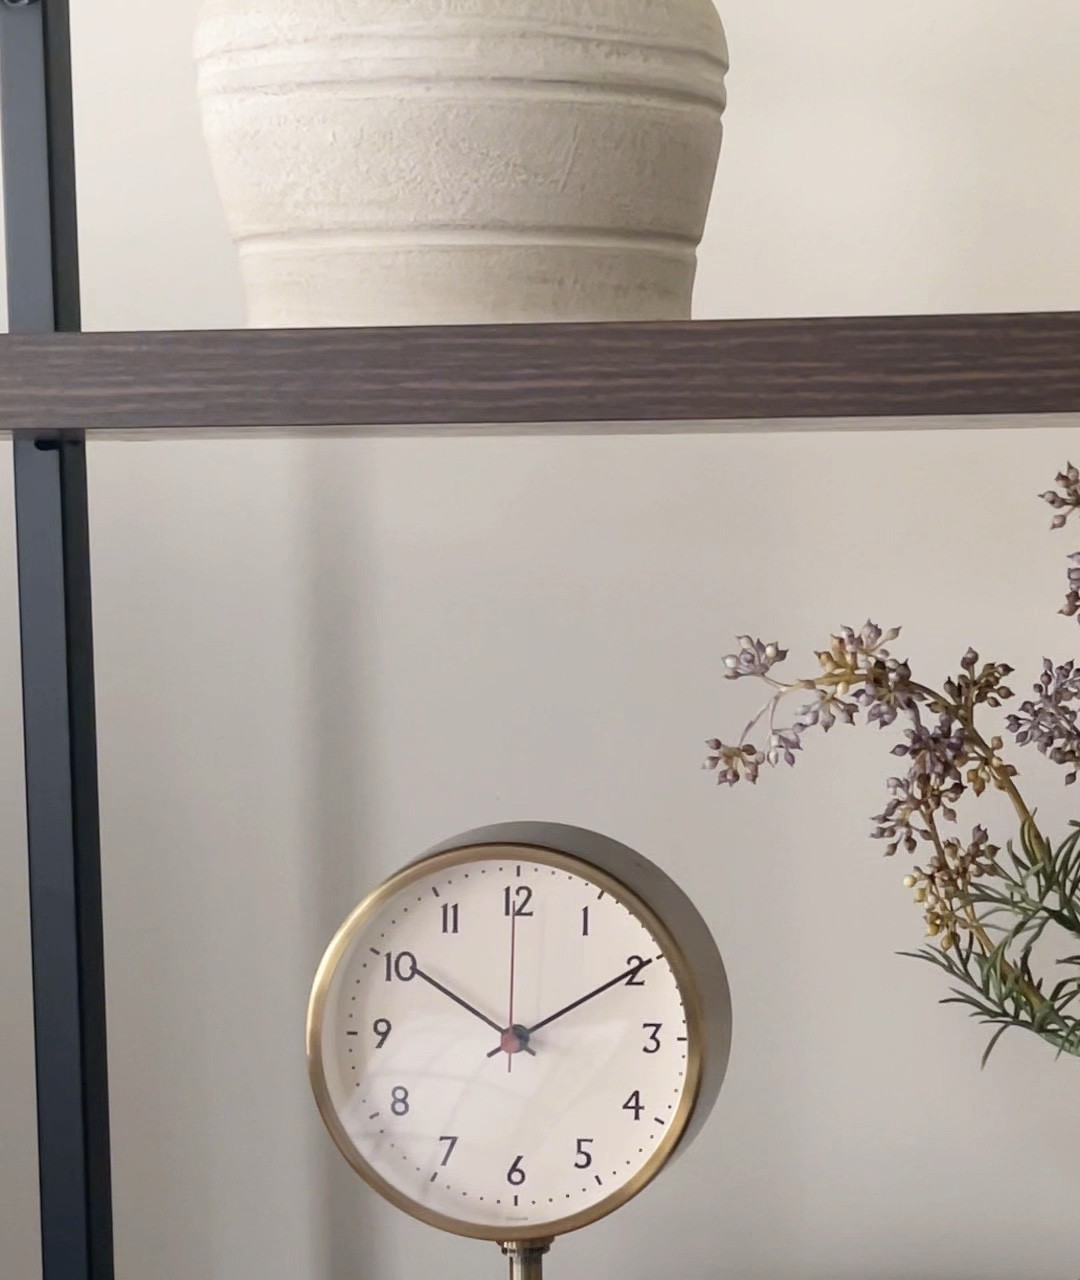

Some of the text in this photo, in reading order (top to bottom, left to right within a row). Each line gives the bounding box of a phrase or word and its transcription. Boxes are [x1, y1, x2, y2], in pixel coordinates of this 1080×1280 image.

[503, 885, 534, 917] 12
[441, 903, 459, 934] 11
[581, 906, 589, 936] 1
[384, 951, 418, 982] 10
[624, 955, 646, 986] 2
[372, 1018, 393, 1049] 9
[642, 1023, 662, 1054] 3
[390, 1086, 410, 1117] 8
[622, 1090, 645, 1121] 4
[438, 1136, 459, 1167] 7
[573, 1139, 594, 1170] 5
[506, 1155, 526, 1186] 6
